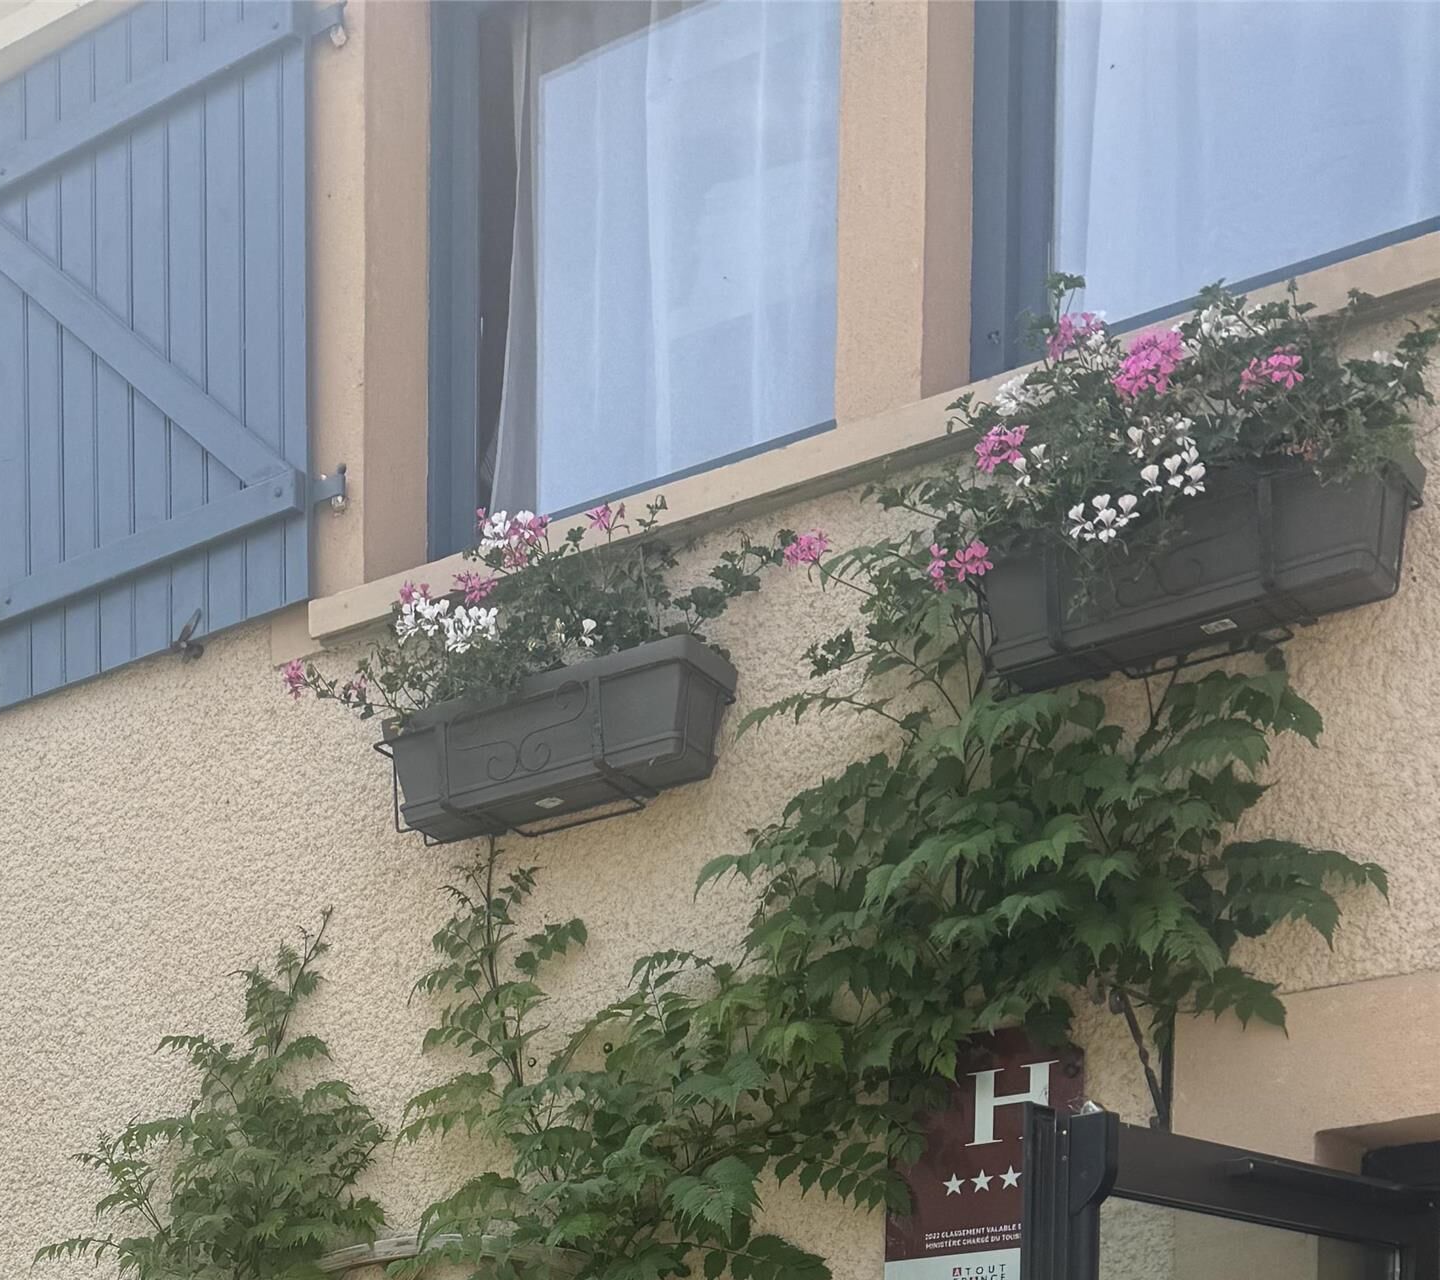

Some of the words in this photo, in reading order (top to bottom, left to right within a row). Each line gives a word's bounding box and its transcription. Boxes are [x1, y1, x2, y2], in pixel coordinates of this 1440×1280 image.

[965, 1060, 1060, 1147] H
[941, 1227, 985, 1239] CLASSEMENT
[986, 1224, 1017, 1234] VALABLE
[990, 1235, 1000, 1243] DU
[952, 1264, 1006, 1277] ATOUT
